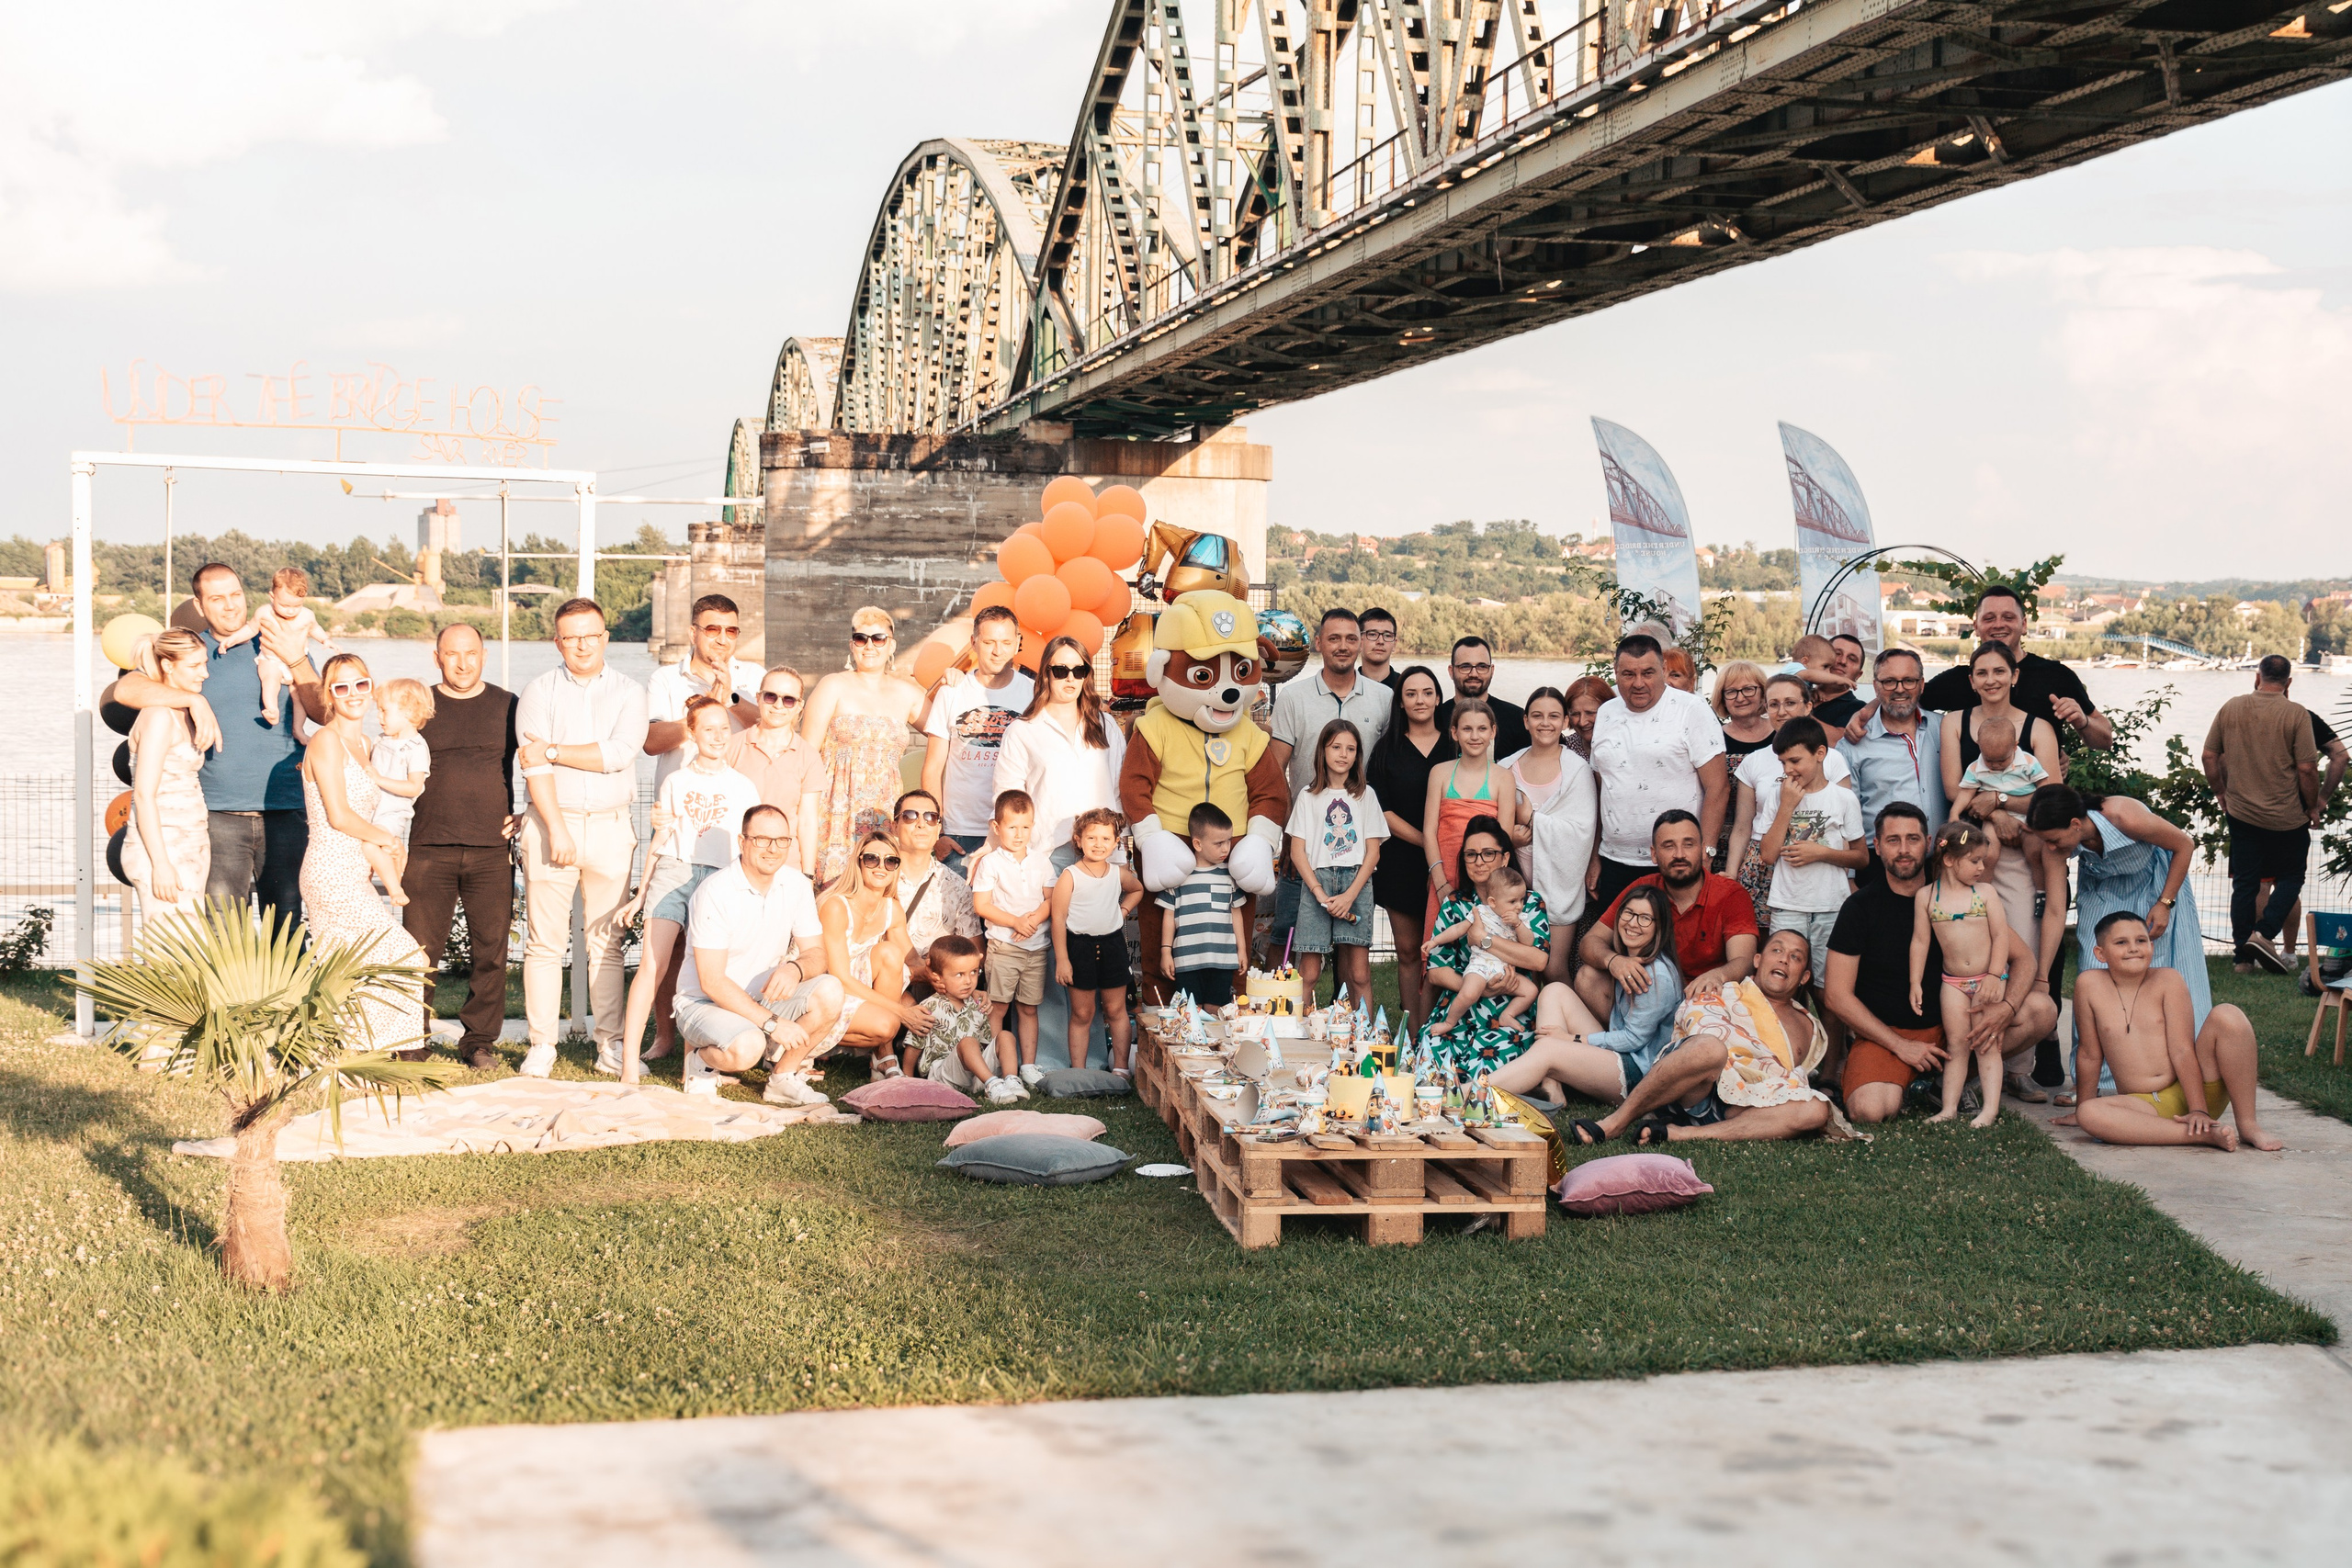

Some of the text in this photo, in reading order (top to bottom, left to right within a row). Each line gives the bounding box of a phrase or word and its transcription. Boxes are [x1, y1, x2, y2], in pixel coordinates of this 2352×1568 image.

[100, 357, 564, 442] UNDER THE BRIDGE HOUSE
[683, 790, 727, 808] SELF
[684, 805, 729, 824] LOVE
